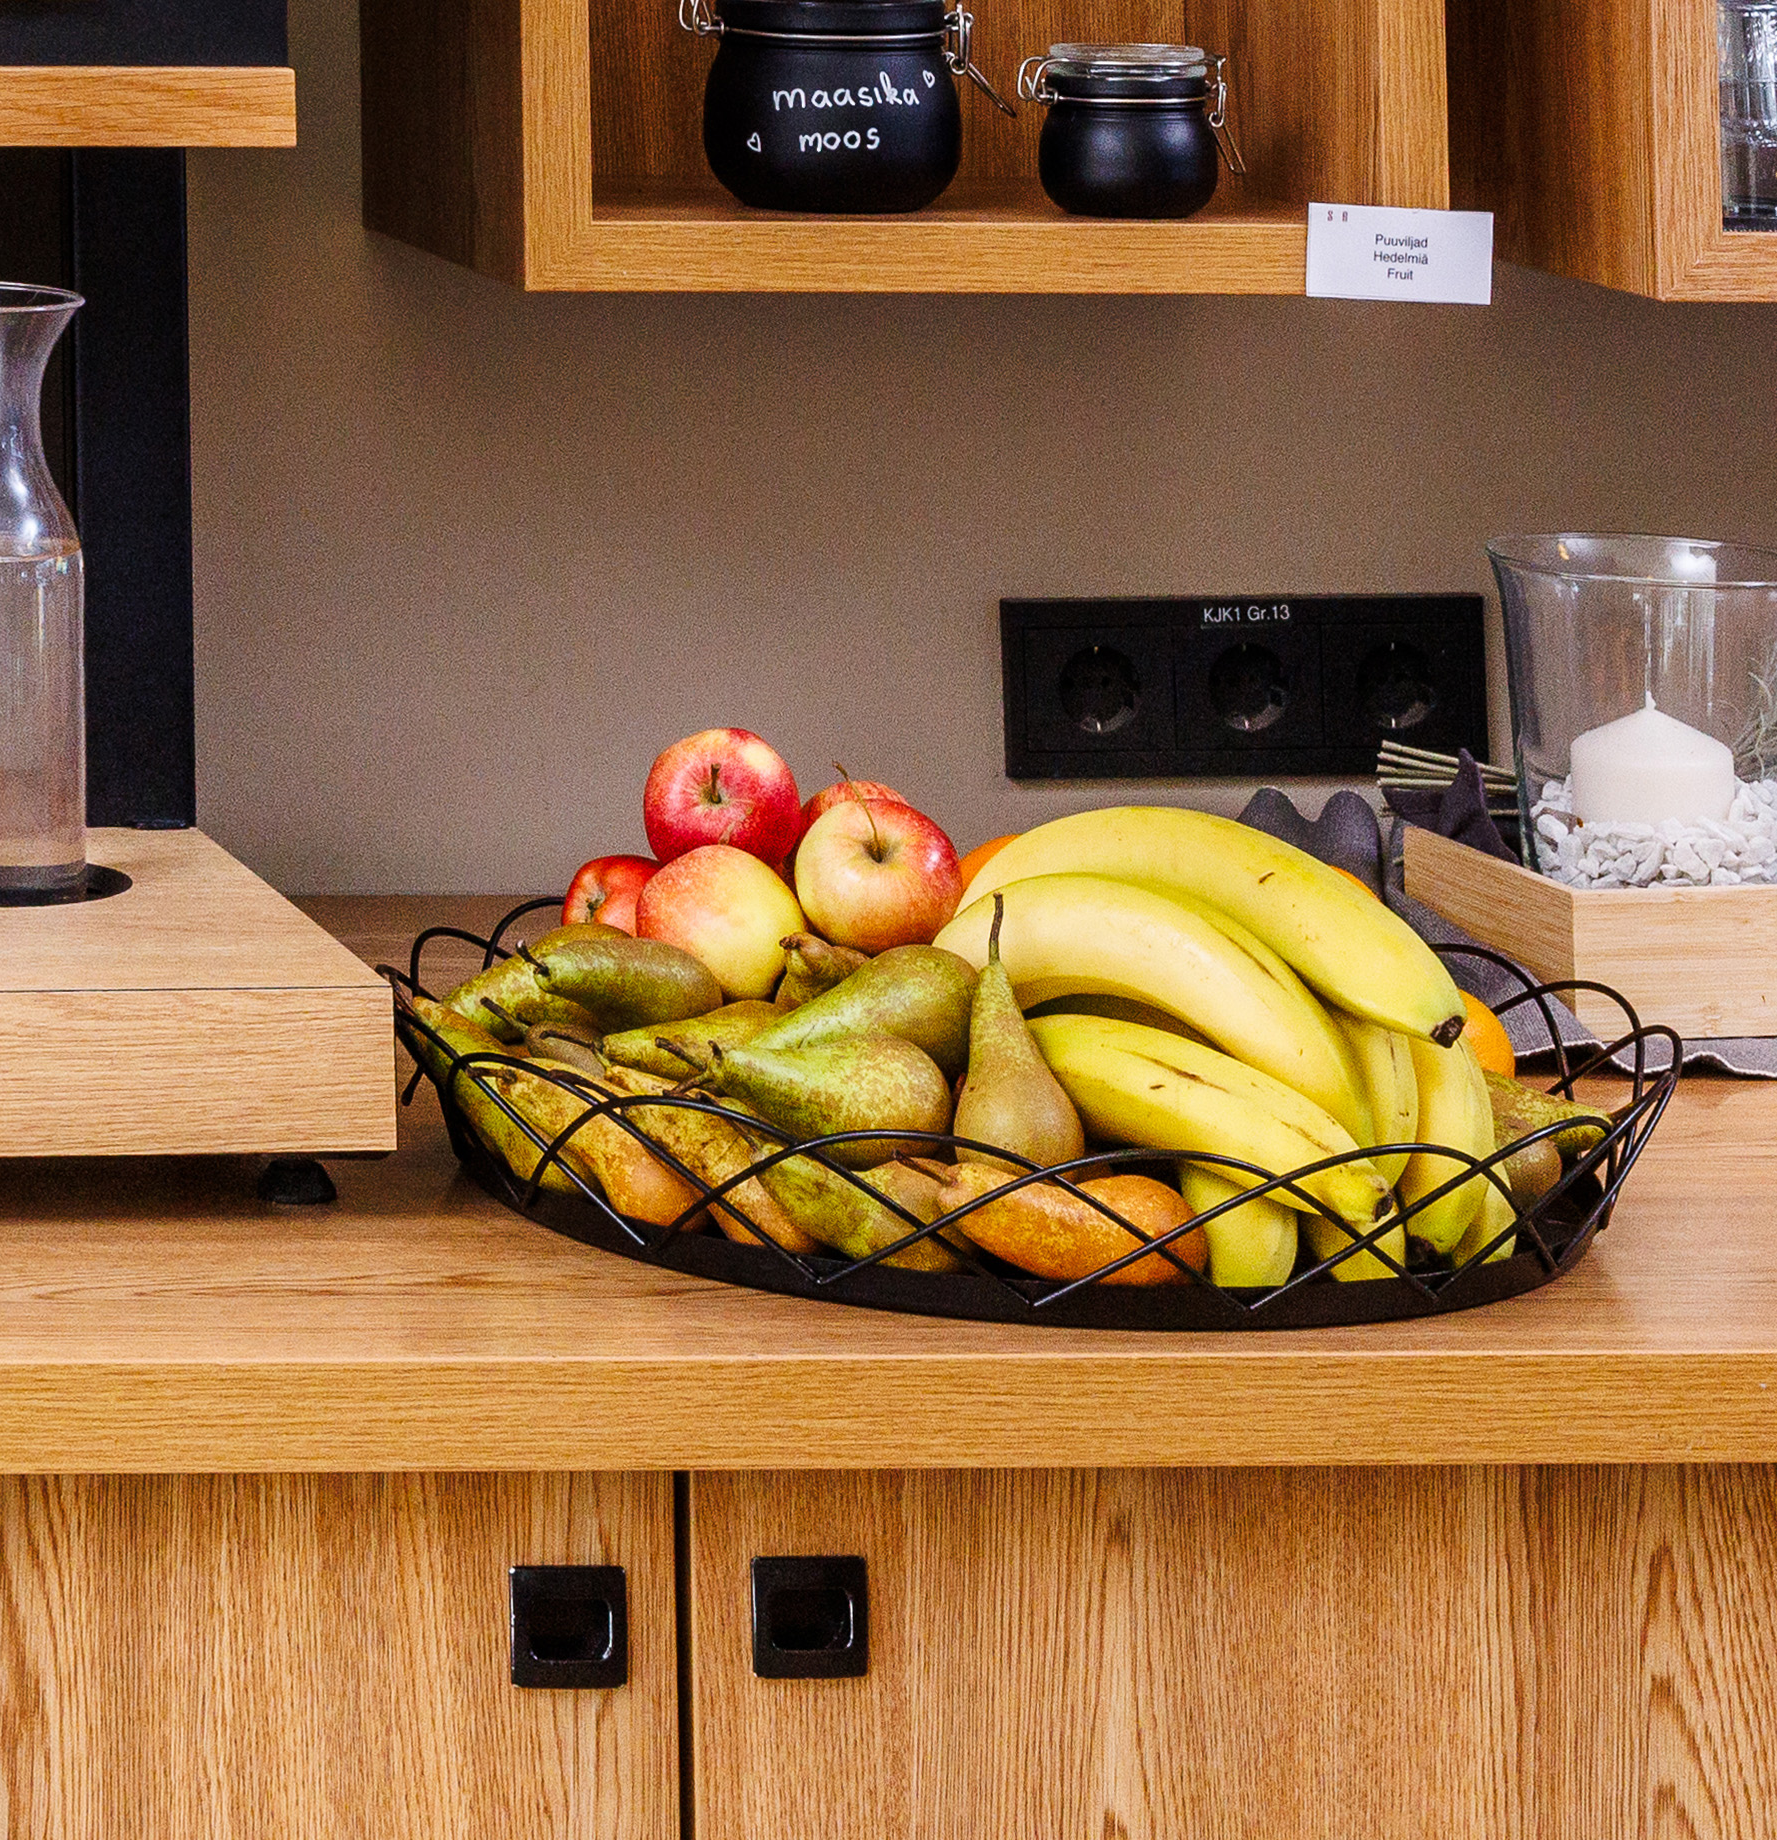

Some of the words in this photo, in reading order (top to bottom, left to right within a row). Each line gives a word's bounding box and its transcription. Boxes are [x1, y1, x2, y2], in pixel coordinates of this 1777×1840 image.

[772, 71, 921, 111] maasika
[798, 127, 881, 153] moos
[1375, 233, 1429, 250] Puuviljad
[1373, 250, 1429, 265] Hedelmiä
[1387, 267, 1414, 281] Fruit
[1203, 606, 1241, 623] KJK1
[1247, 604, 1291, 621] Gr.13
